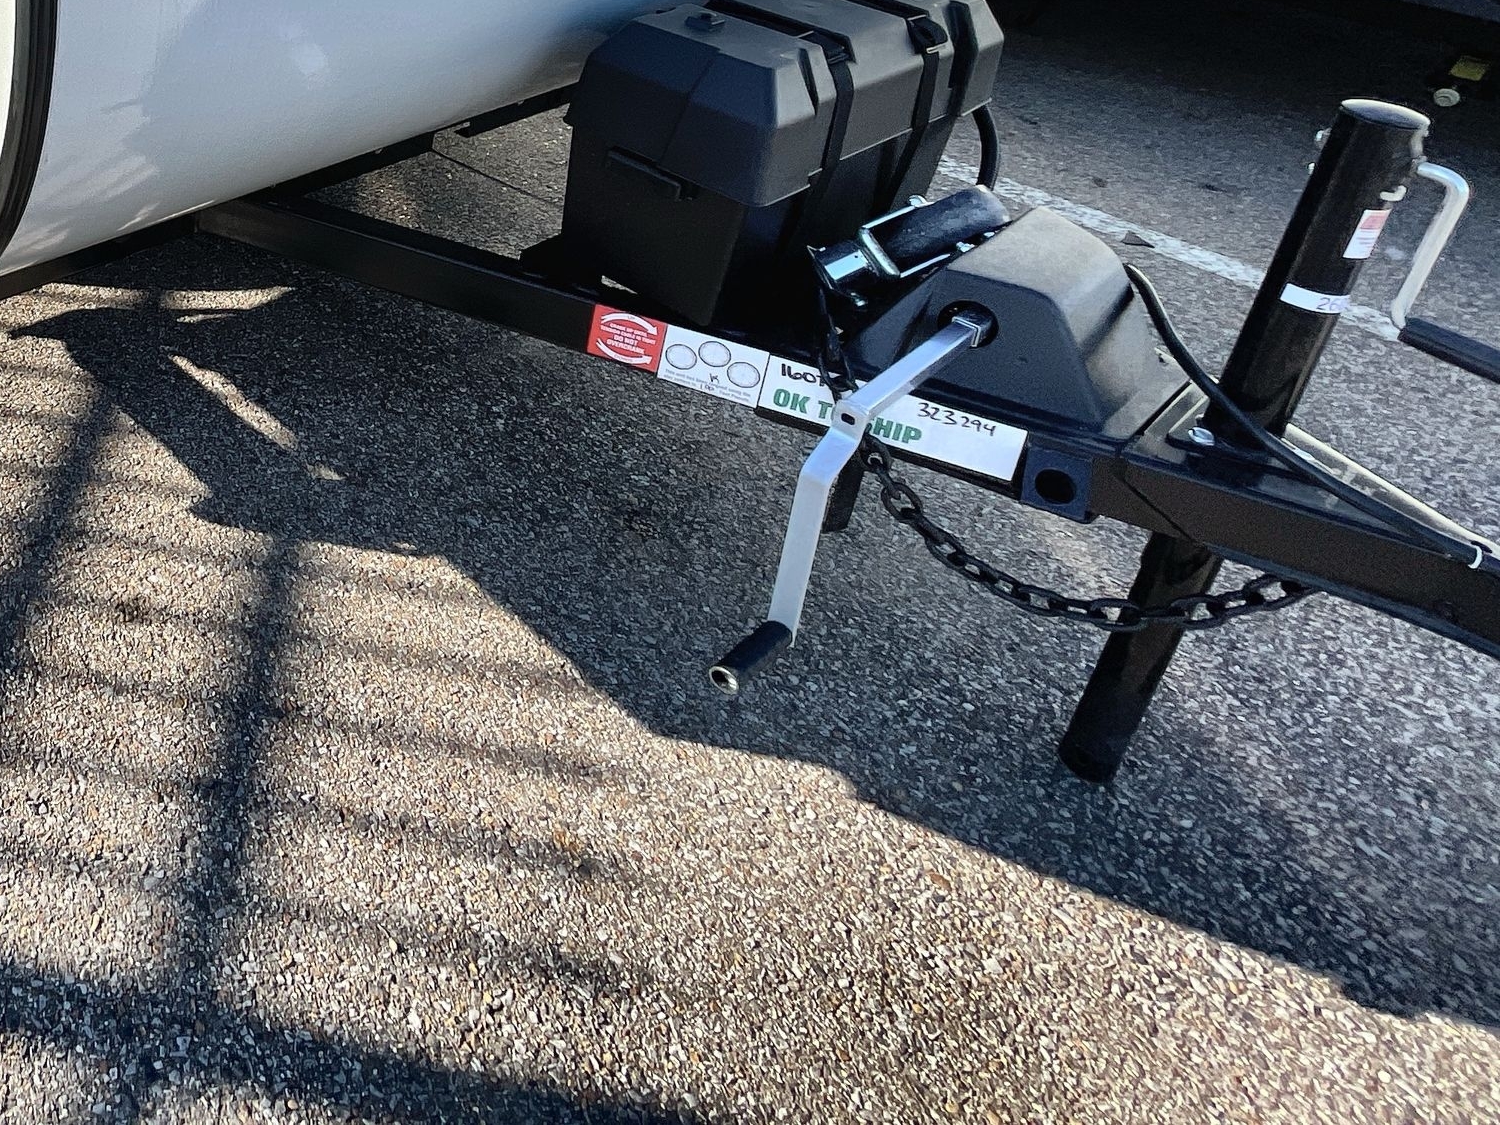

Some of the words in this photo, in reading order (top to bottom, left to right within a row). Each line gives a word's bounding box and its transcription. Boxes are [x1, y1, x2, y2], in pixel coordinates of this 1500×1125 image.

[1316, 296, 1349, 312] 26
[606, 338, 645, 354] OVERCRANK
[613, 334, 624, 342] DO
[624, 337, 639, 346] NOT
[773, 388, 811, 414] OK
[818, 400, 834, 419] T
[872, 417, 922, 443] HIP
[917, 402, 997, 437] 323294
